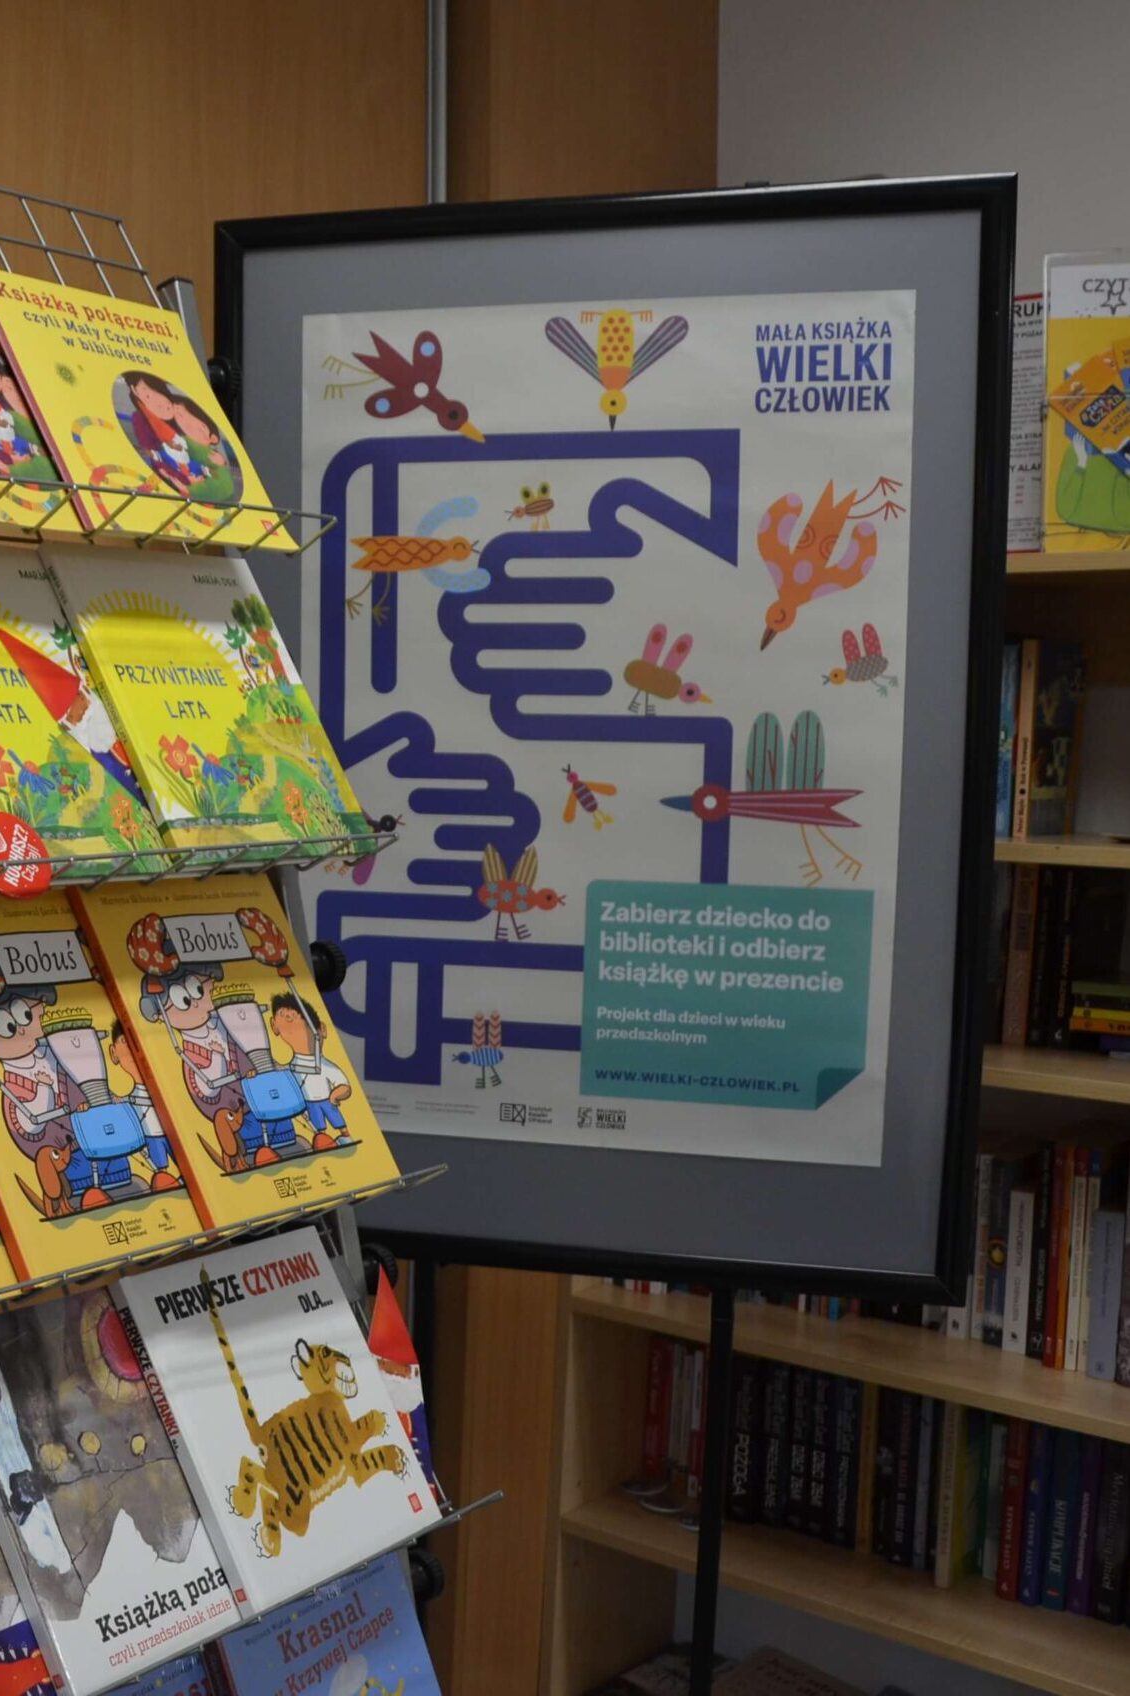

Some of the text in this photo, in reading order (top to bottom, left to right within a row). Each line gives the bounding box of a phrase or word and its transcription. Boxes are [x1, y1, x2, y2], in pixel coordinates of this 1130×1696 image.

[23, 311, 172, 355] czyli Mały Czytelnik
[82, 304, 180, 341] połączeni,
[756, 316, 892, 343] MAŁA KSIĄŻKA
[63, 336, 152, 366] w bibliotece
[756, 343, 892, 383] WIELKI
[755, 385, 891, 414] CZŁOWIEK
[164, 700, 211, 720] LATA
[600, 902, 831, 931] Zabierz dziecko do
[176, 921, 238, 953] Bobuś
[600, 931, 826, 961] biblioteki i odbierz
[3, 939, 77, 975] Bobuś
[599, 960, 844, 992] książkę w prezencie
[597, 1006, 786, 1029] Projekt dla dzieci w wieku
[596, 1026, 707, 1046] przedszkolnym
[155, 1252, 320, 1324] PIERWSZE CZYTANKI
[119, 1306, 179, 1437] PIERWSZE CZYTANKI
[95, 1590, 186, 1643] Książką
[109, 1598, 232, 1667] czyli przedszkolak idzie
[276, 1590, 367, 1664] Krasnal
[346, 1606, 395, 1651] Czapce
